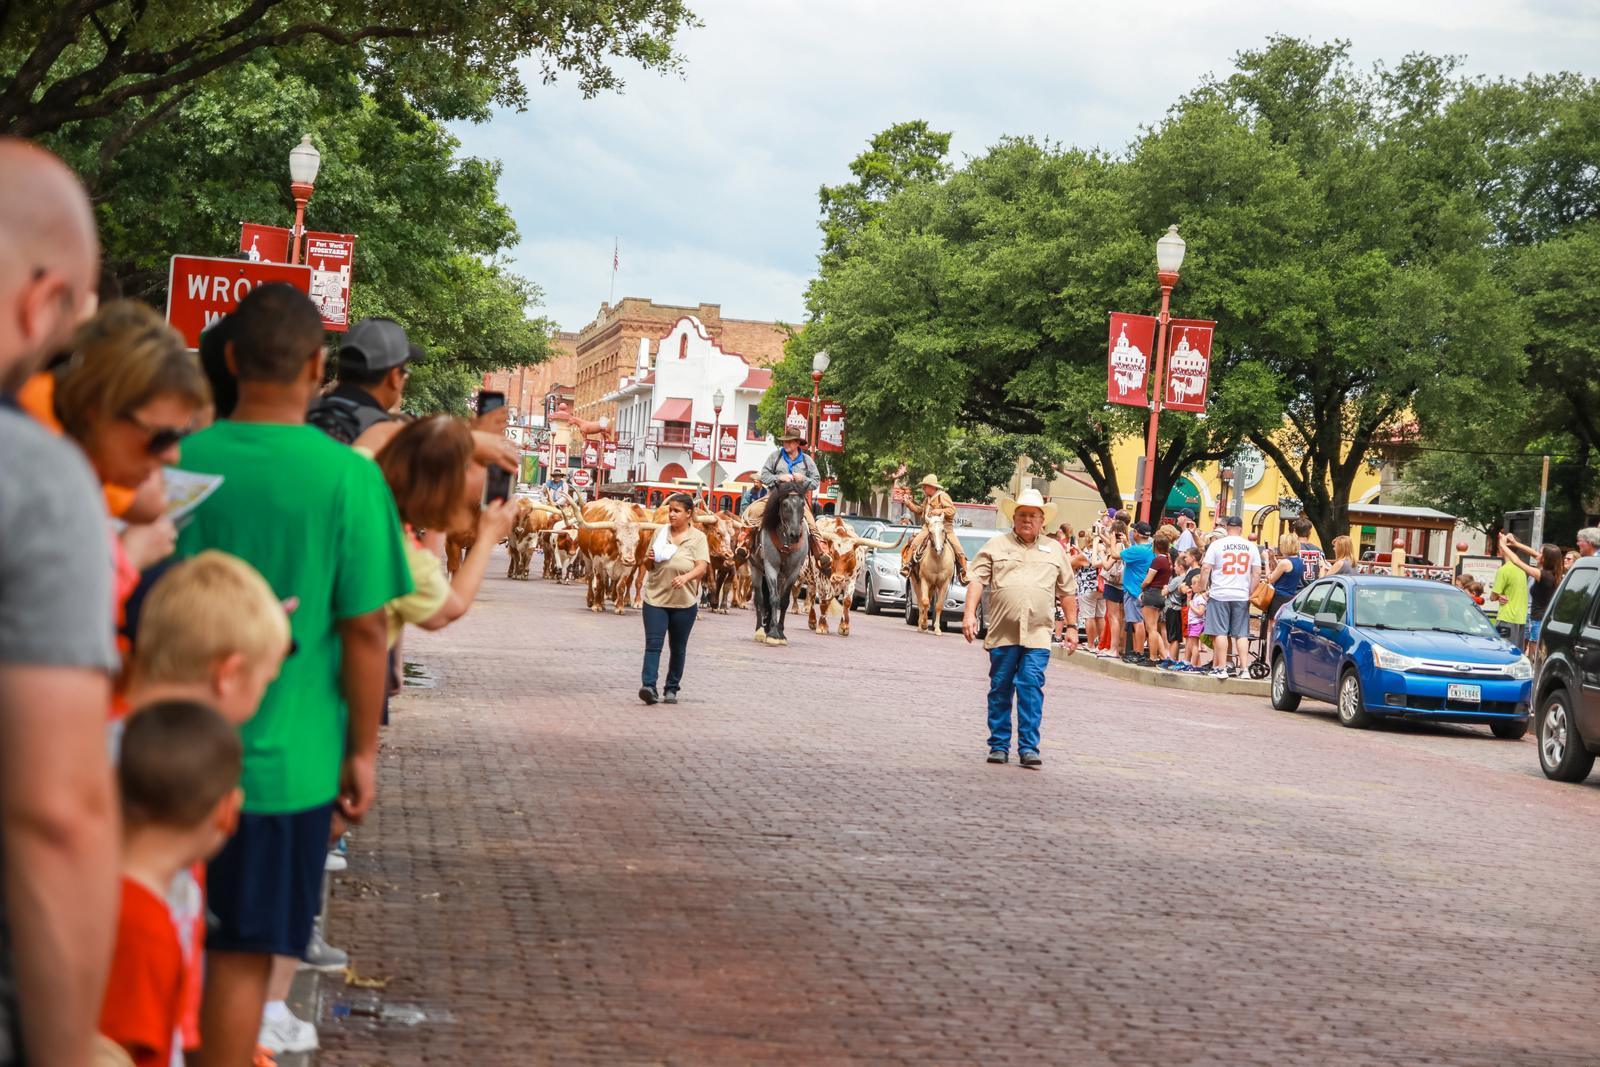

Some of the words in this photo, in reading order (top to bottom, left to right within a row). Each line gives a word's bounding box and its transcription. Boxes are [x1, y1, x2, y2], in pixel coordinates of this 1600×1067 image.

[188, 273, 263, 303] WRO
[1222, 543, 1250, 552] JACKSON
[1222, 552, 1250, 575] 29
